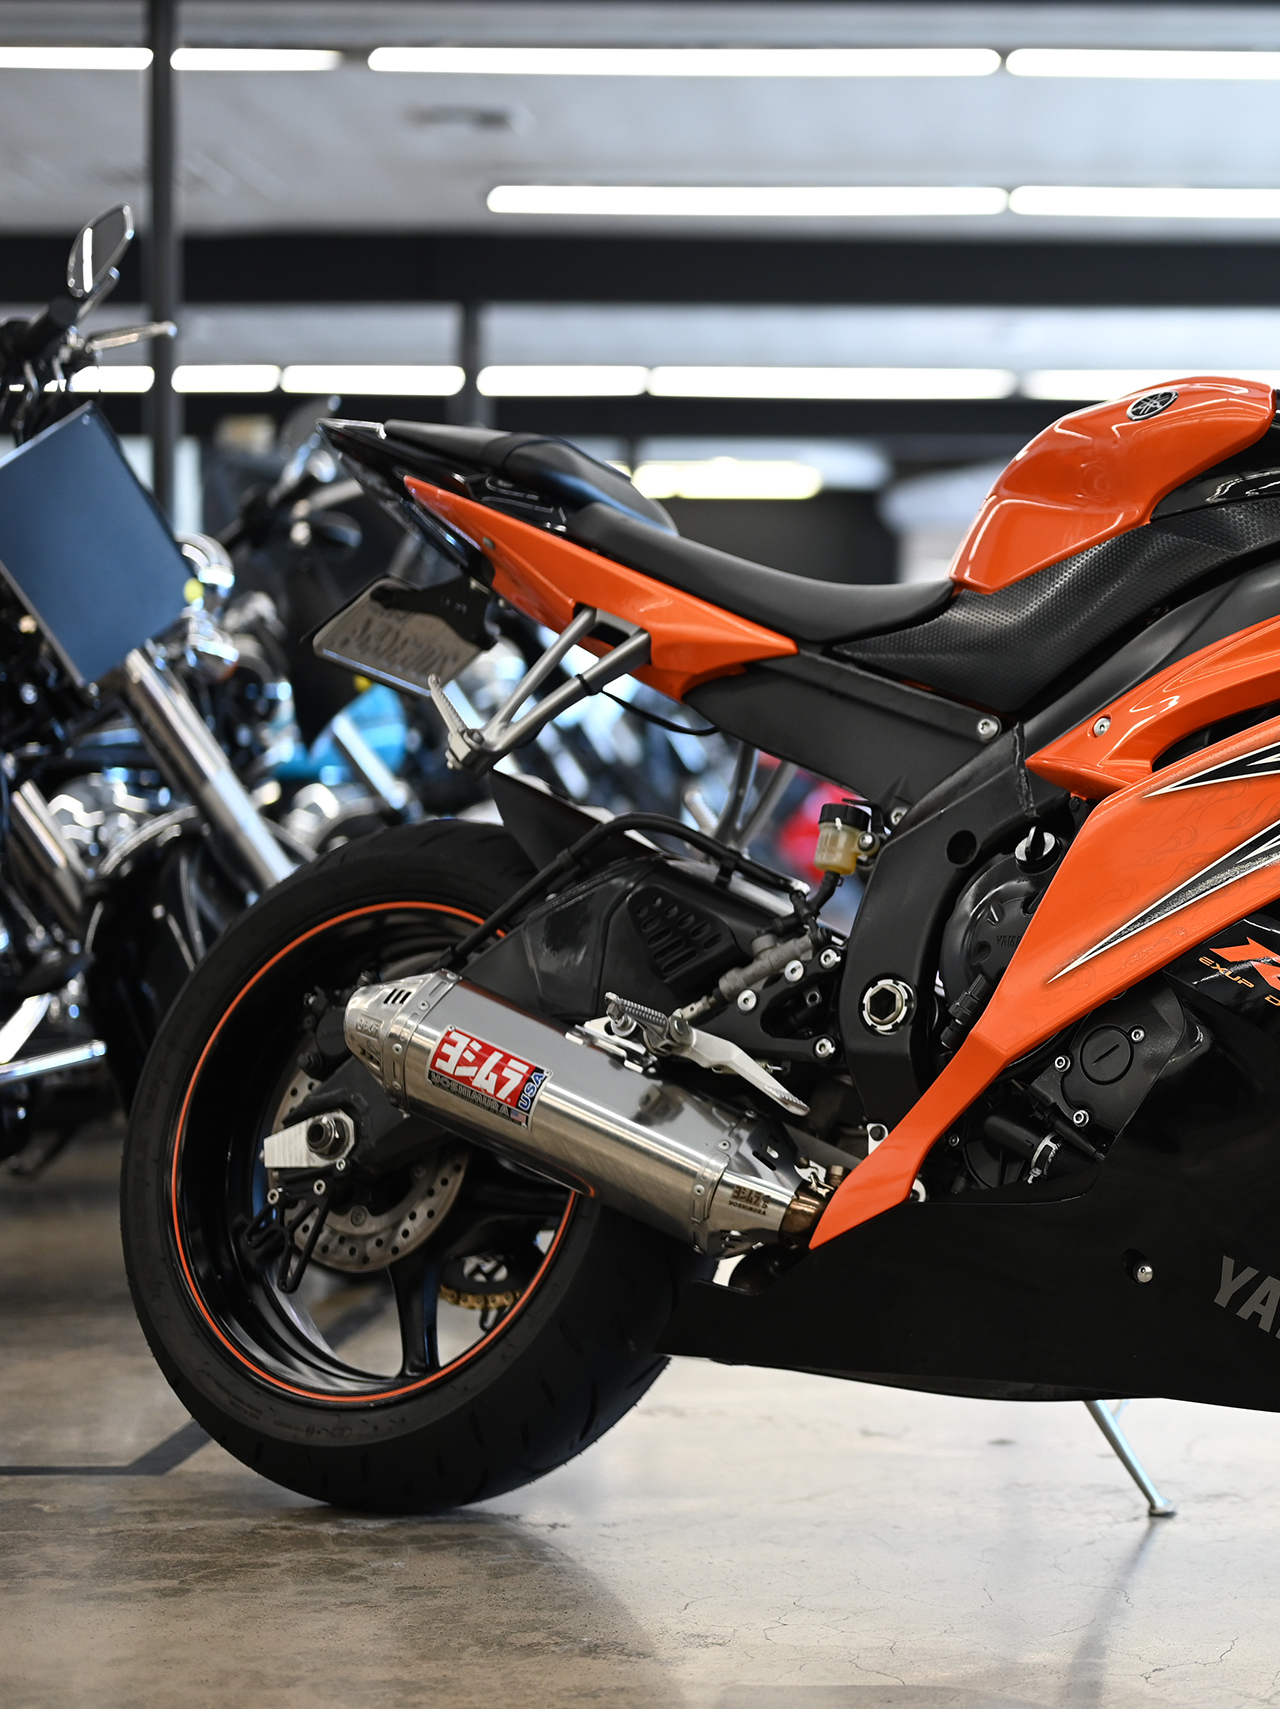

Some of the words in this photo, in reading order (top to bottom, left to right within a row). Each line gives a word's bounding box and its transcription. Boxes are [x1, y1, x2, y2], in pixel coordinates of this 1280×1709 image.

[1199, 956, 1255, 988] EXUP
[431, 1072, 510, 1117] YOSHIMURA
[518, 1072, 544, 1110] USA
